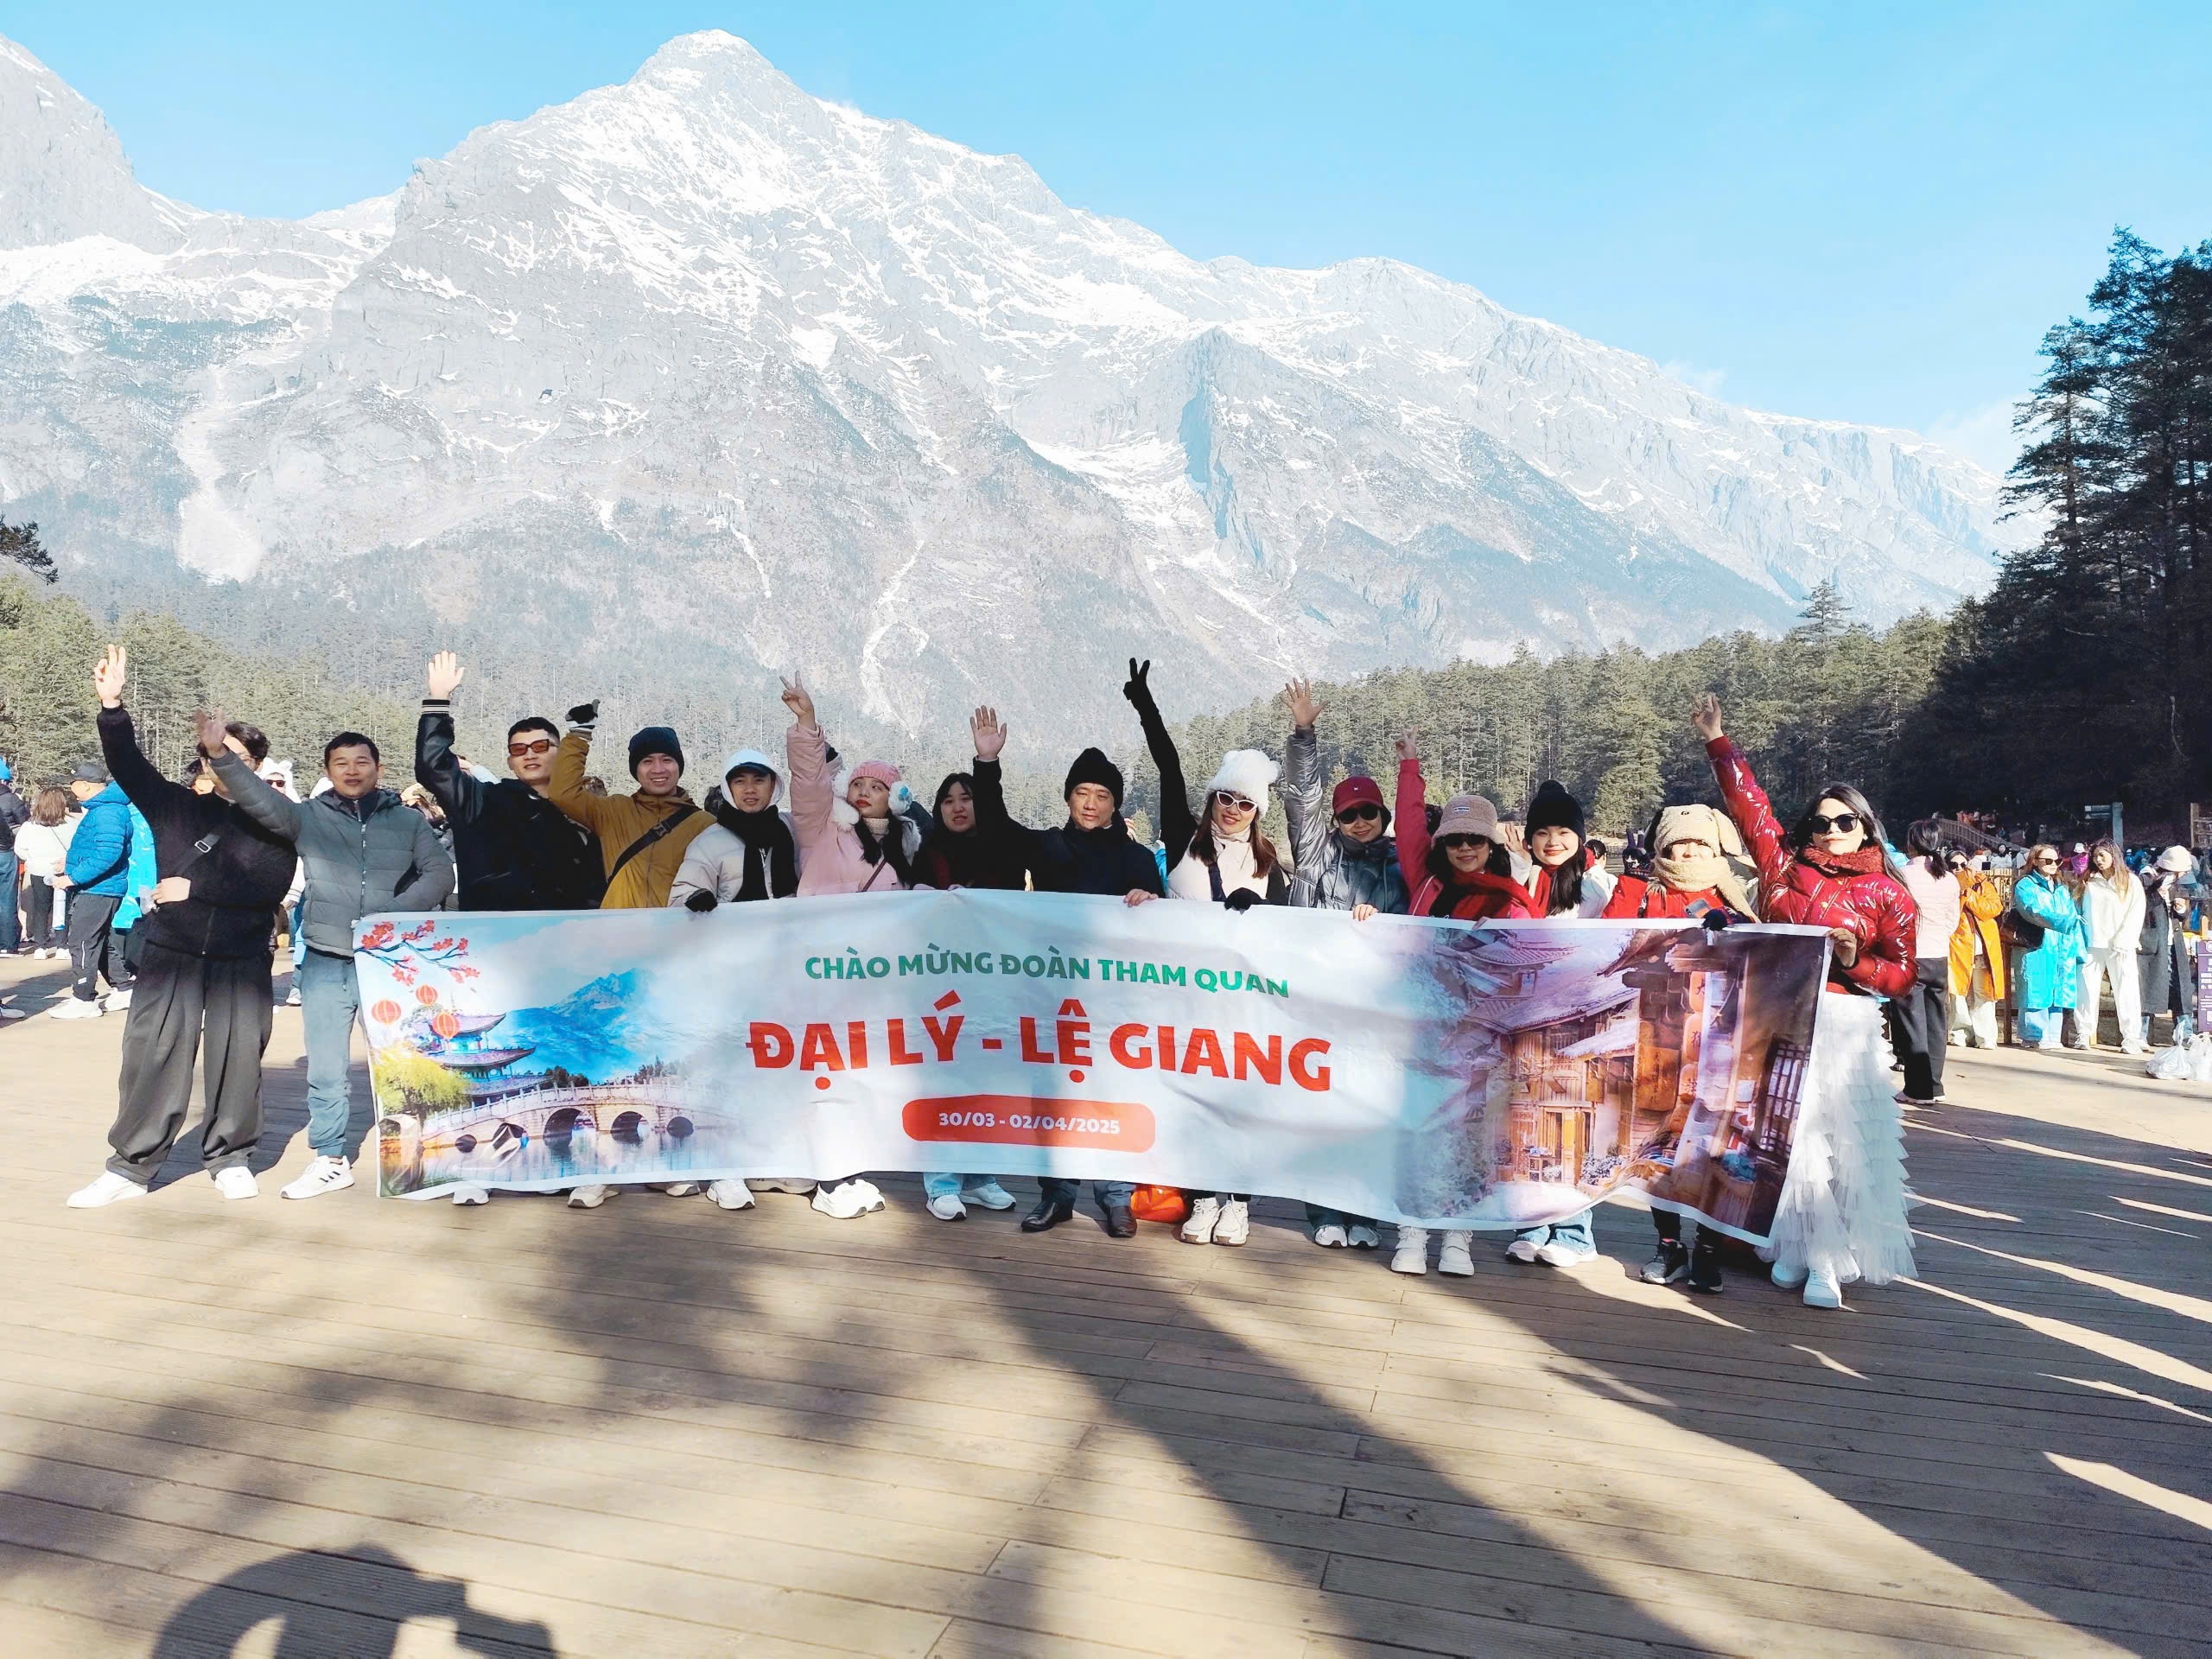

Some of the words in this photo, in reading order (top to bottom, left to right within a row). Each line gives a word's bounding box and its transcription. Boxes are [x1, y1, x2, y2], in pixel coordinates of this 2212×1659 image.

[804, 946, 891, 980] CHÀO
[898, 942, 993, 976] MỪNG
[999, 945, 1090, 980] ĐOÀN
[1096, 958, 1187, 987] THAM
[1194, 968, 1289, 999] QUAN
[746, 1020, 868, 1090] ĐẠI
[887, 989, 964, 1065] LÝ
[982, 1038, 1002, 1050] -
[1020, 998, 1092, 1084] LỆ
[1109, 1022, 1332, 1092] GIANG
[938, 1111, 995, 1128] 30/03
[1009, 1114, 1121, 1135] 02/04/2025
